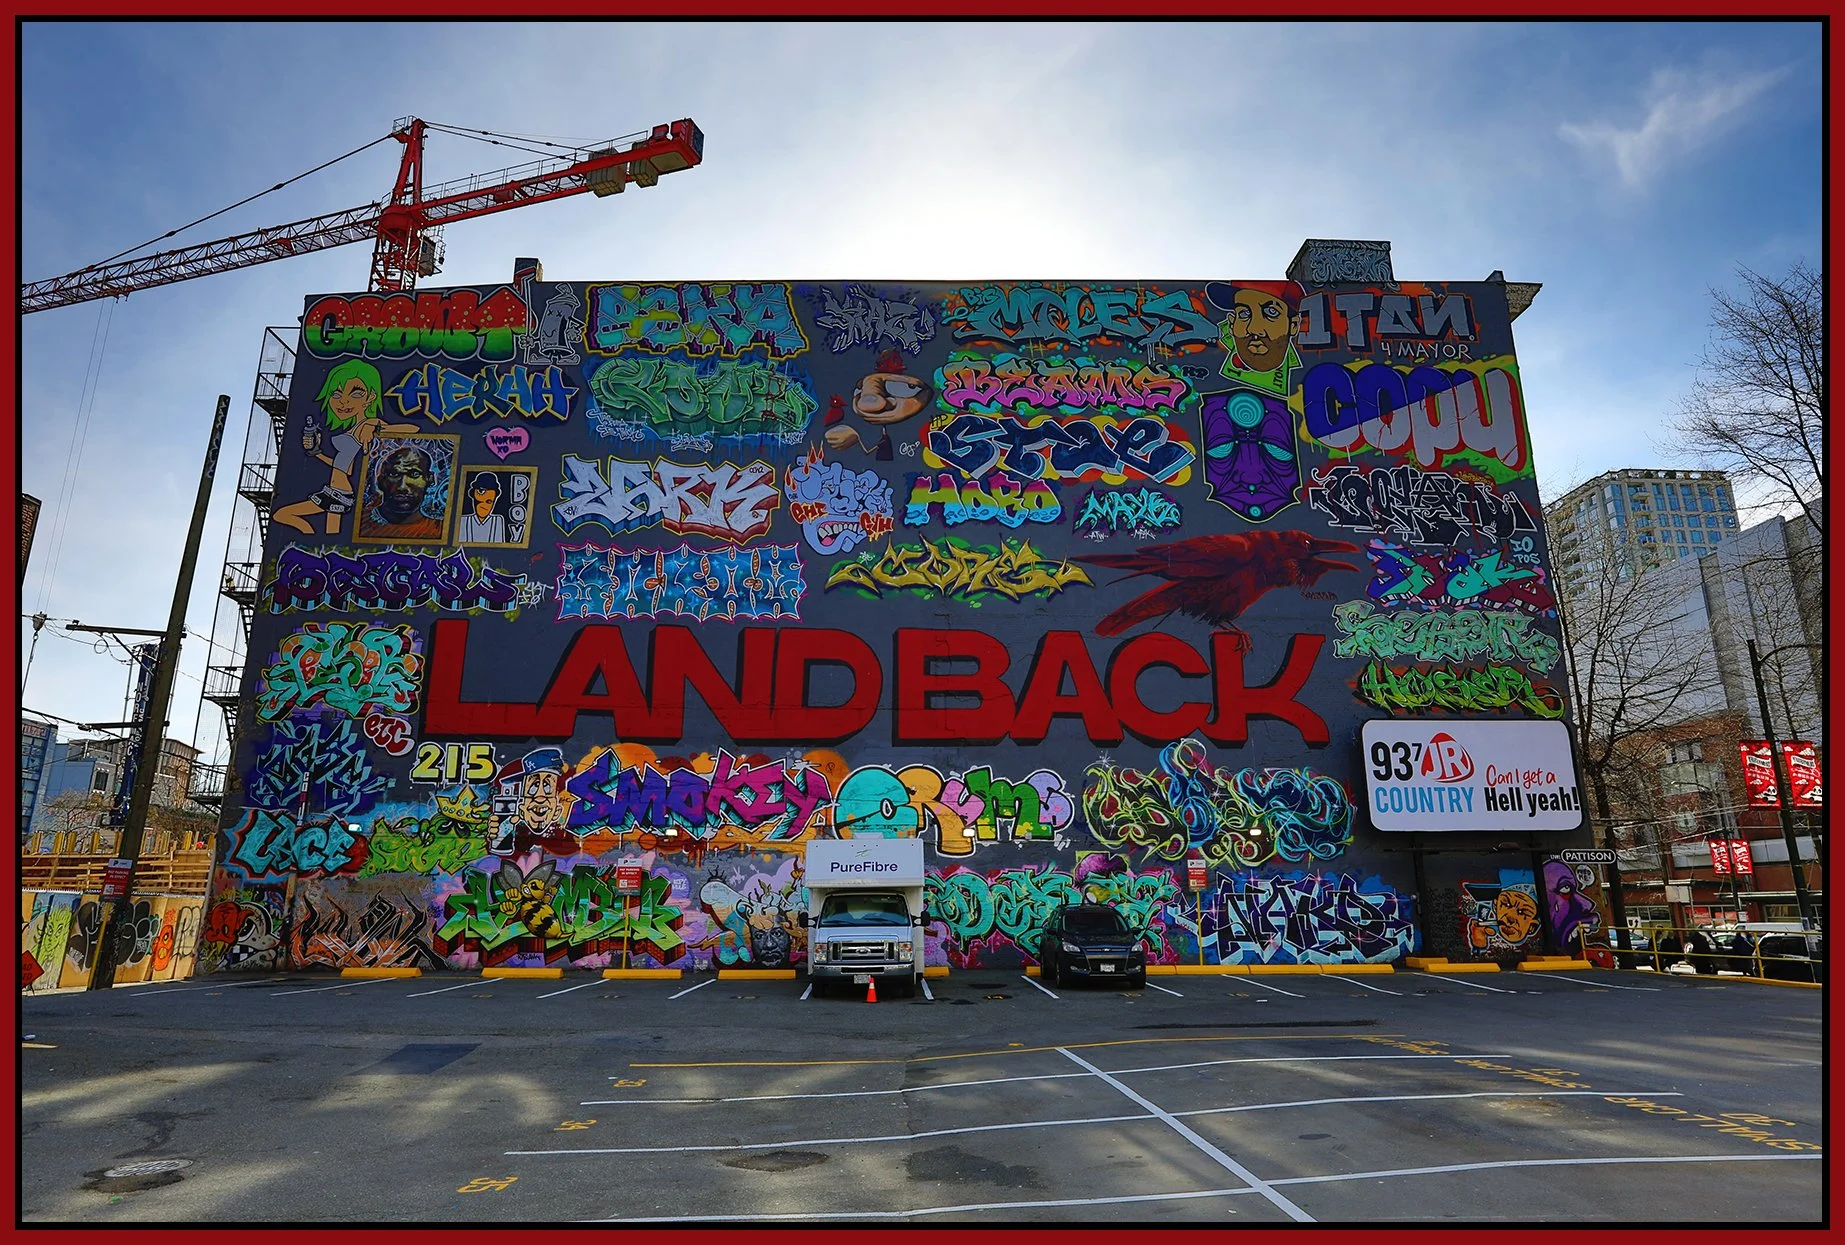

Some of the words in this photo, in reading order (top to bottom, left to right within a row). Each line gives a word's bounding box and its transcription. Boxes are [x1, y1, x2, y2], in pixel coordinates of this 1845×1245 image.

[1398, 342, 1473, 362] MAYOR
[508, 473, 531, 543] BOY
[903, 472, 1063, 528] HOBO
[410, 742, 498, 784] 215
[1486, 764, 1513, 787] Can
[1523, 768, 1543, 790] get
[1546, 771, 1556, 783] a
[1375, 786, 1474, 813] COUNTRY
[1484, 787, 1523, 812] Hell
[1526, 787, 1580, 818] yeah!
[830, 861, 898, 873] PureFibre
[1565, 852, 1612, 860] PATTISON
[1603, 1096, 1688, 1115] CAR
[553, 1119, 598, 1131] 34
[456, 1175, 520, 1194] 35
